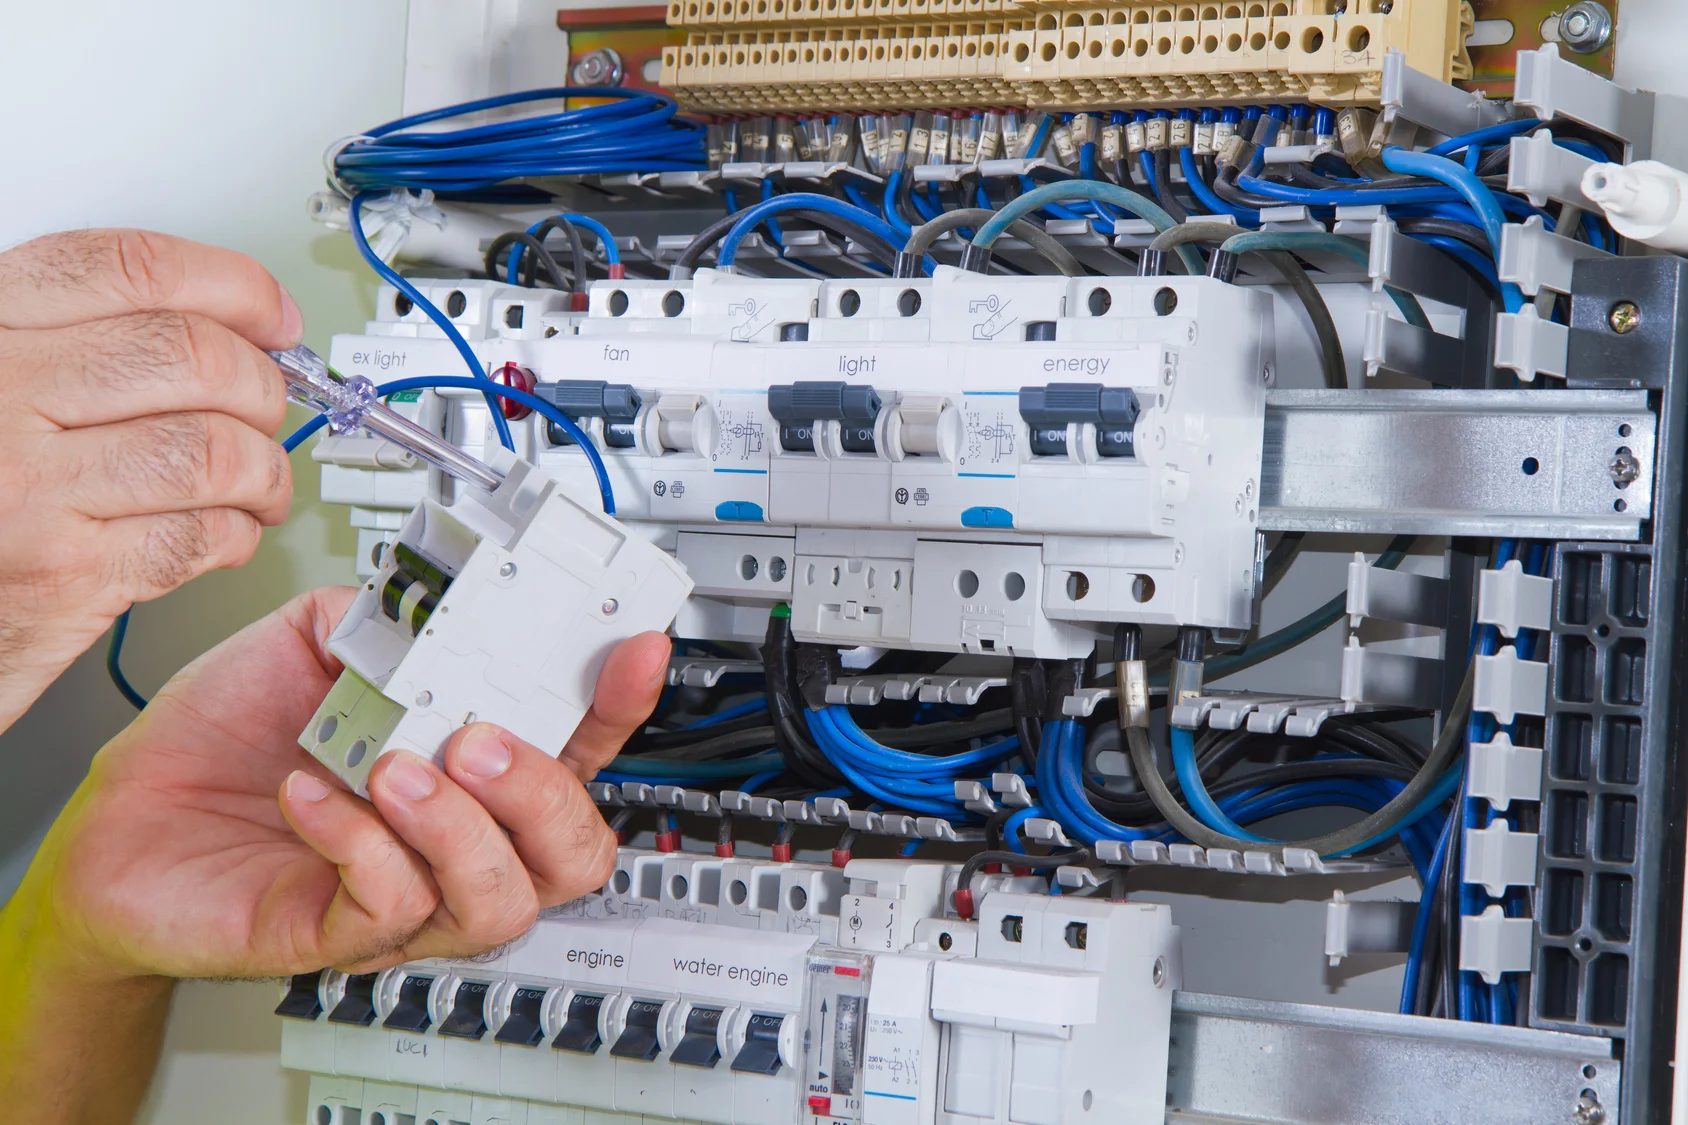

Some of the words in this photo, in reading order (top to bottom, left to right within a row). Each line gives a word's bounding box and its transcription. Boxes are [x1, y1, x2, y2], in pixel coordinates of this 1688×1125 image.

[1341, 50, 1376, 66] 34
[913, 129, 930, 149] 13
[1148, 122, 1161, 142] 25
[934, 132, 949, 151] 14
[981, 134, 997, 151] 17
[1198, 132, 1212, 150] 27
[352, 351, 370, 364] ex
[373, 350, 408, 370] light
[603, 344, 630, 362] fan
[838, 355, 877, 377] light
[1042, 357, 1111, 375] energy
[403, 393, 419, 401] OF
[1047, 429, 1067, 442] ON
[1113, 431, 1134, 443] ON
[854, 898, 860, 907] 2
[888, 902, 894, 911] 4
[886, 940, 892, 949] 3
[566, 948, 625, 969] engine
[673, 957, 723, 977] water
[727, 966, 789, 987] engine
[882, 1019, 891, 1027] 25
[809, 1084, 829, 1093] auto
